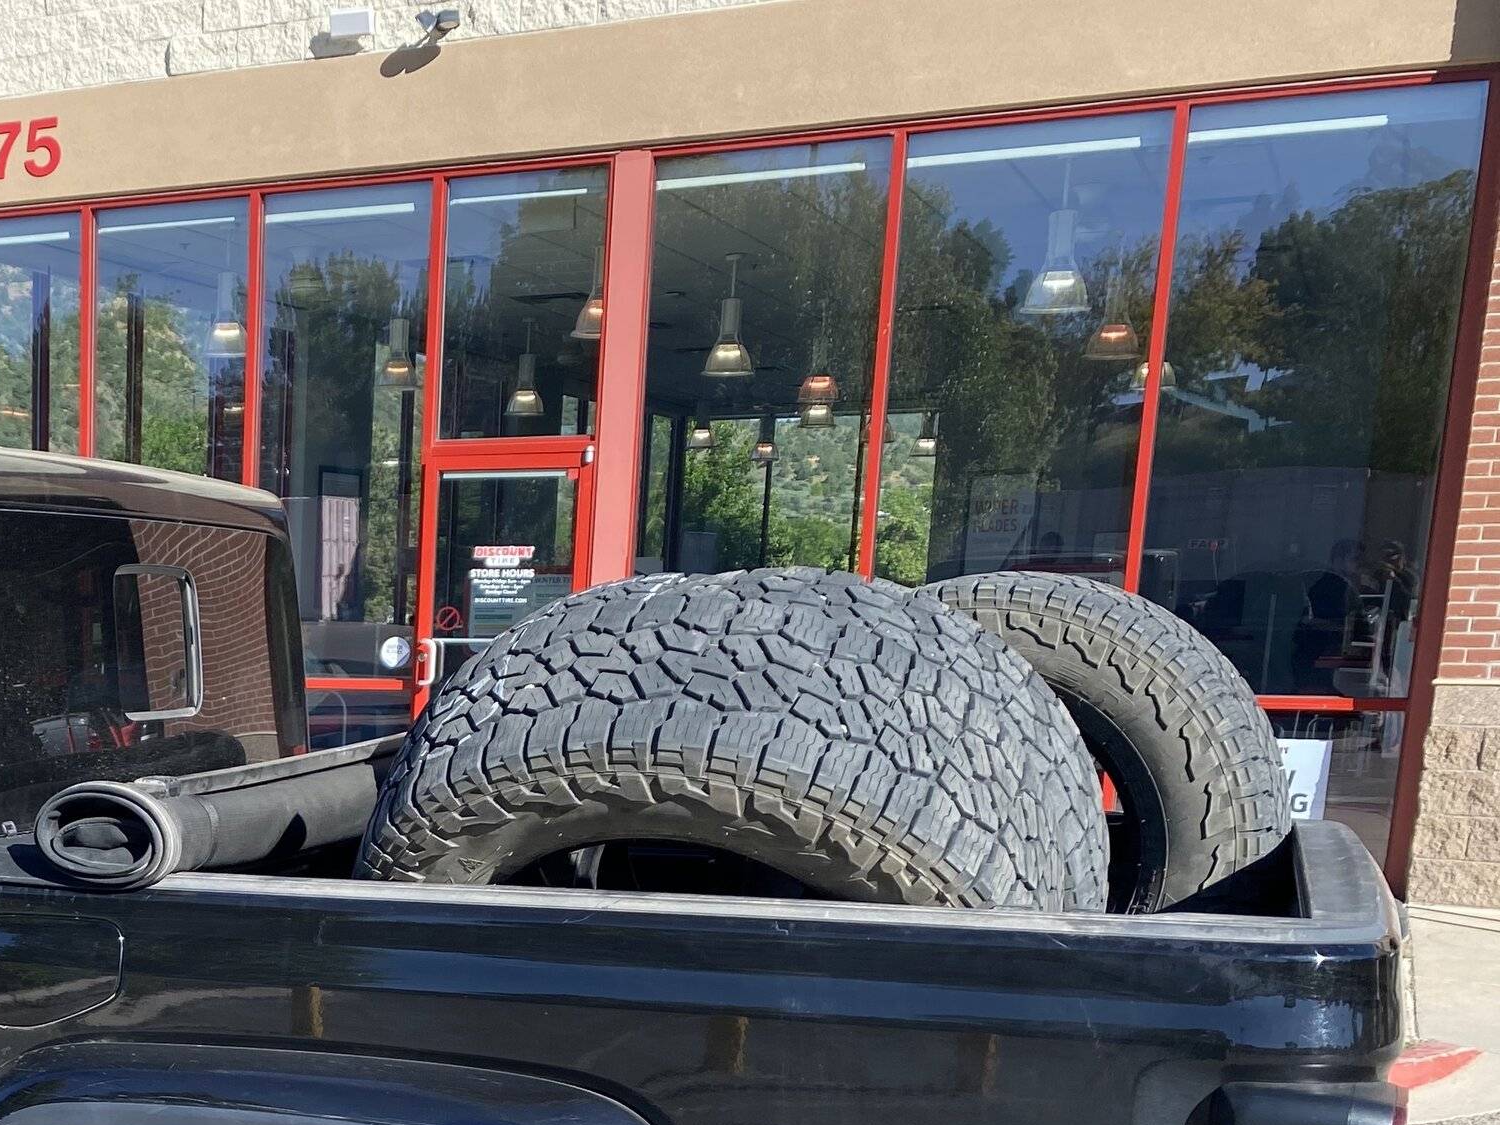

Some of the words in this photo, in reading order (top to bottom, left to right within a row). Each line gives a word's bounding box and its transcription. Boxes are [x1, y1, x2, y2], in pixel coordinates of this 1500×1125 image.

[474, 546, 534, 557] DISCOUNT
[490, 557, 516, 565] TIRE
[470, 569, 501, 579] STORE
[501, 569, 535, 579] HOURS
